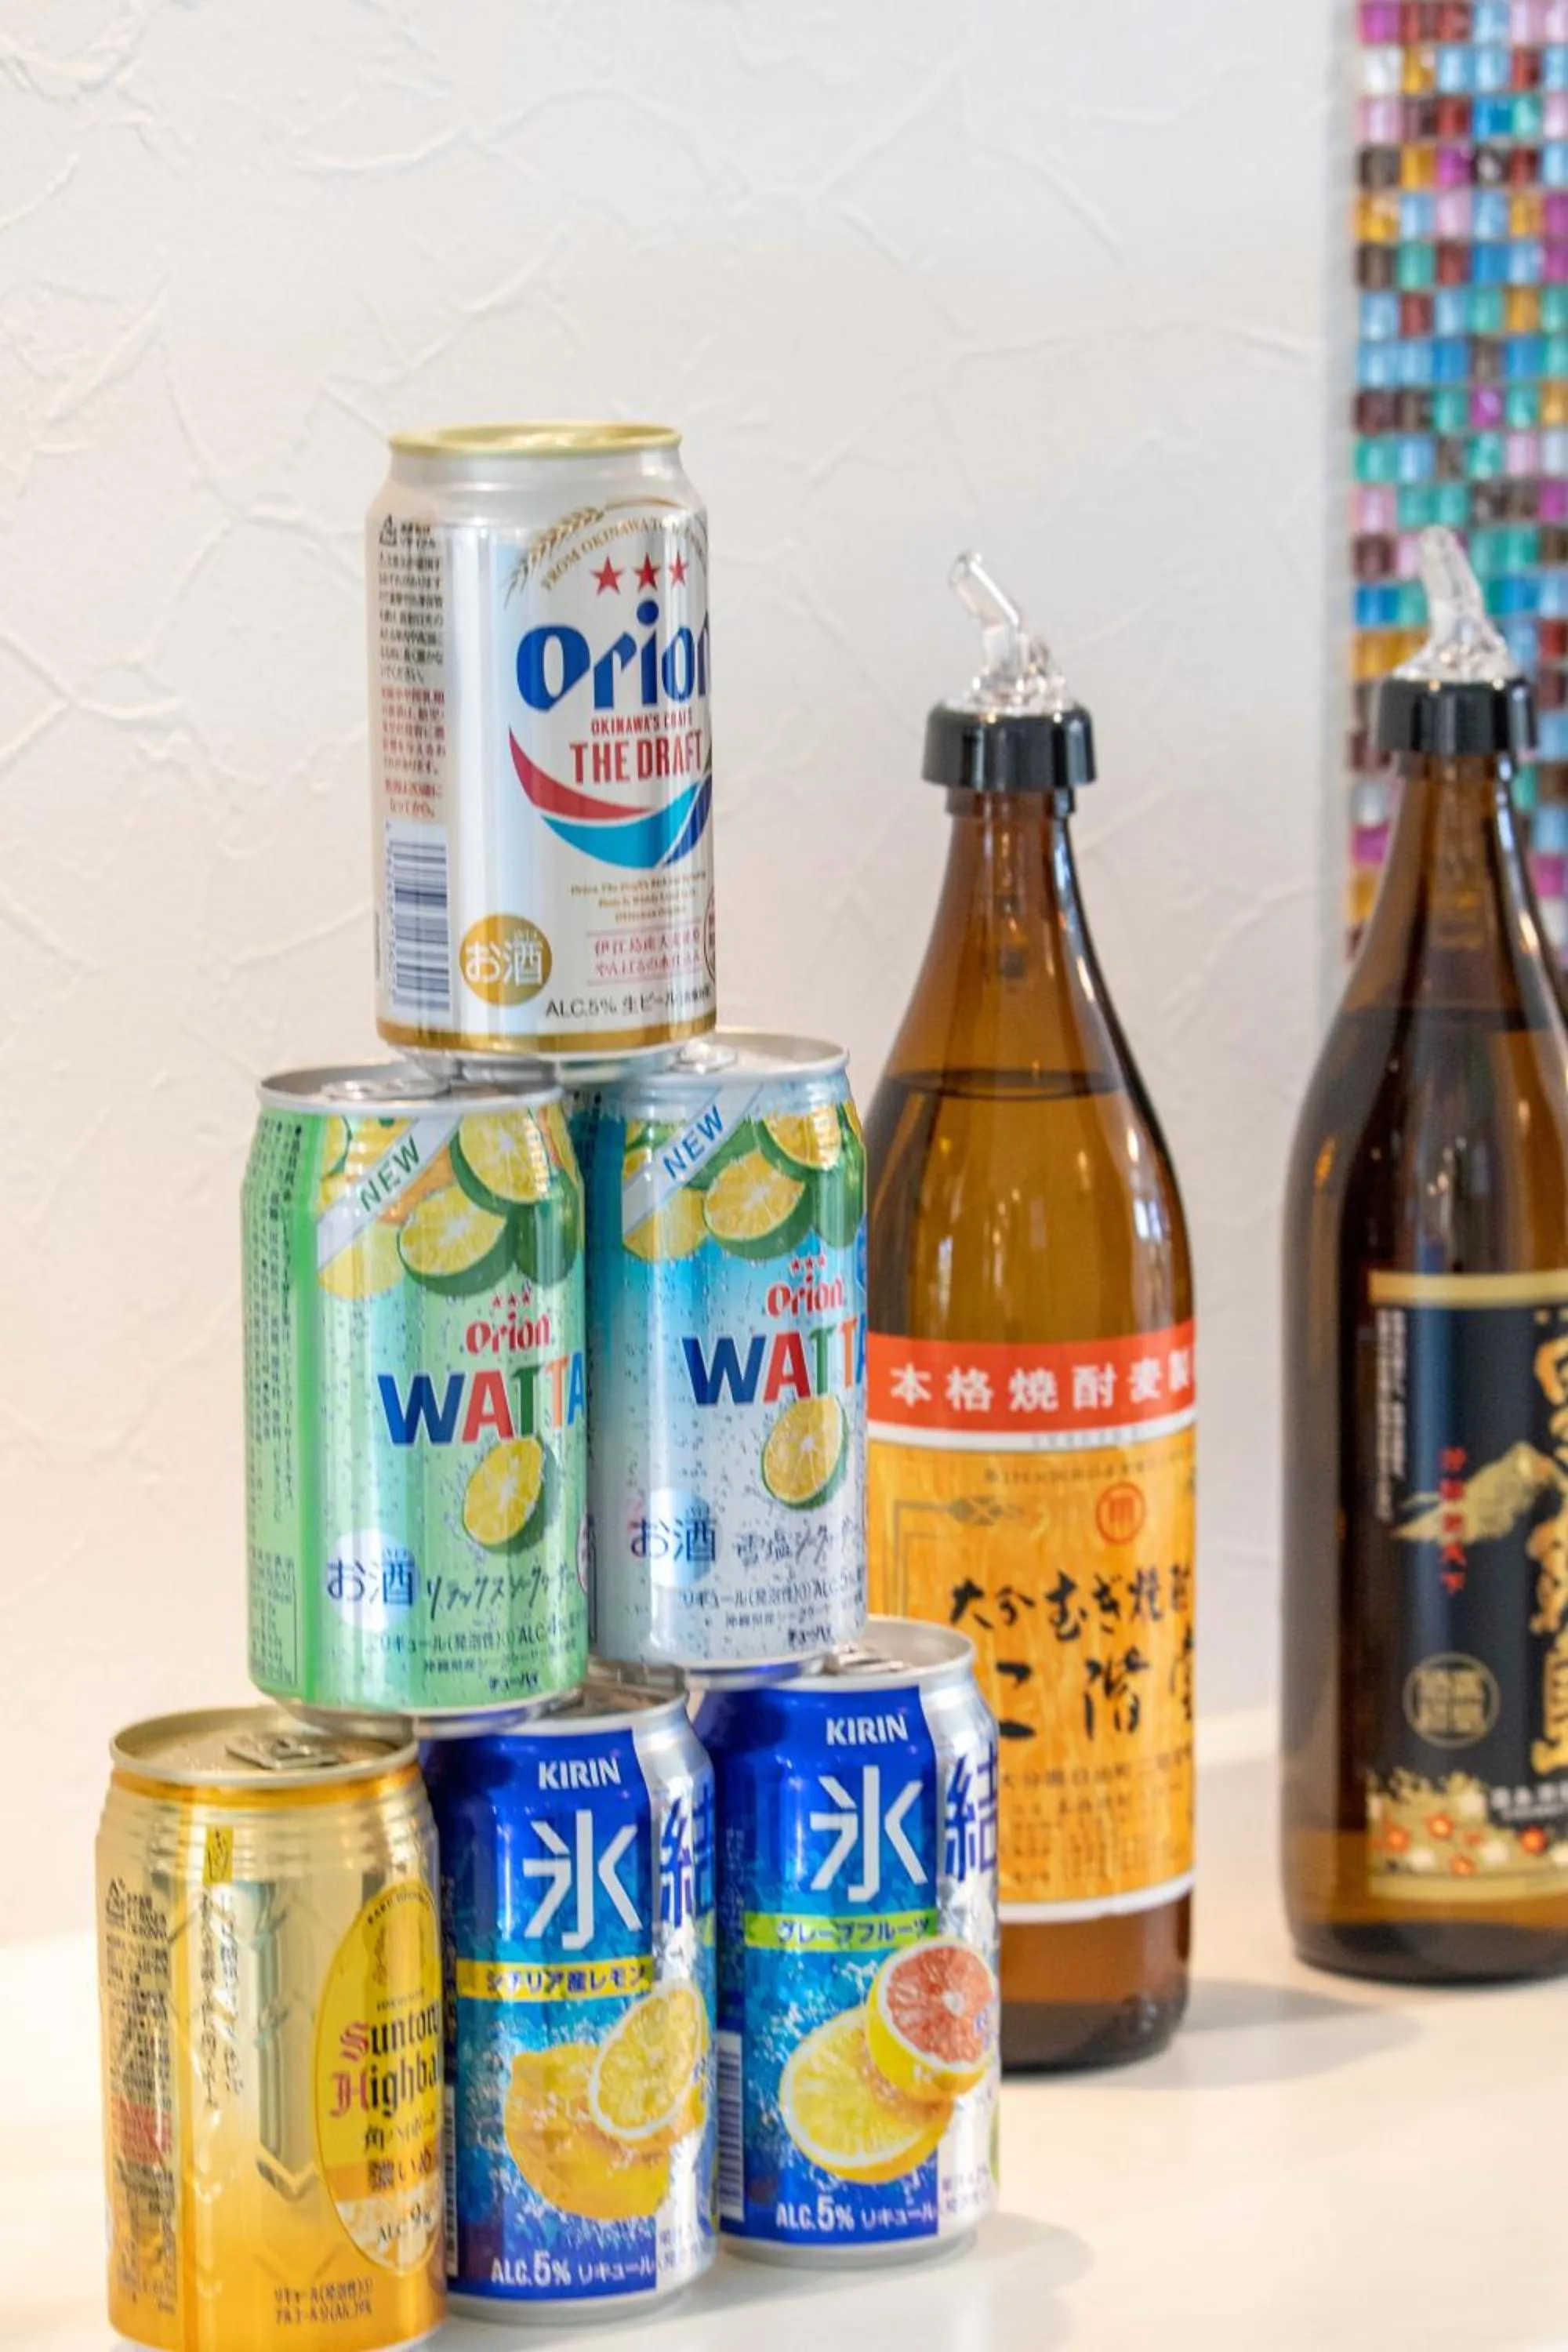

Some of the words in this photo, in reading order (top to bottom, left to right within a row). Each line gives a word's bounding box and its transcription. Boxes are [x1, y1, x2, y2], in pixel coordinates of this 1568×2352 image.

[591, 712, 660, 736] OKINAWA'S
[570, 739, 630, 785] THE
[637, 728, 702, 780] DRAFT
[465, 940, 543, 986] お酒
[662, 1104, 724, 1181] NEW
[358, 1134, 421, 1212] NEW
[377, 1351, 585, 1445] WATTA
[628, 1516, 717, 1562] お酒
[326, 1559, 416, 1606] お酒
[826, 1714, 909, 1746] KIRIN
[538, 1757, 622, 1790] KIRIN
[329, 2050, 437, 2120] Highba
[775, 2194, 855, 2232] ALC.5%
[490, 2249, 572, 2287] ALC.5%
